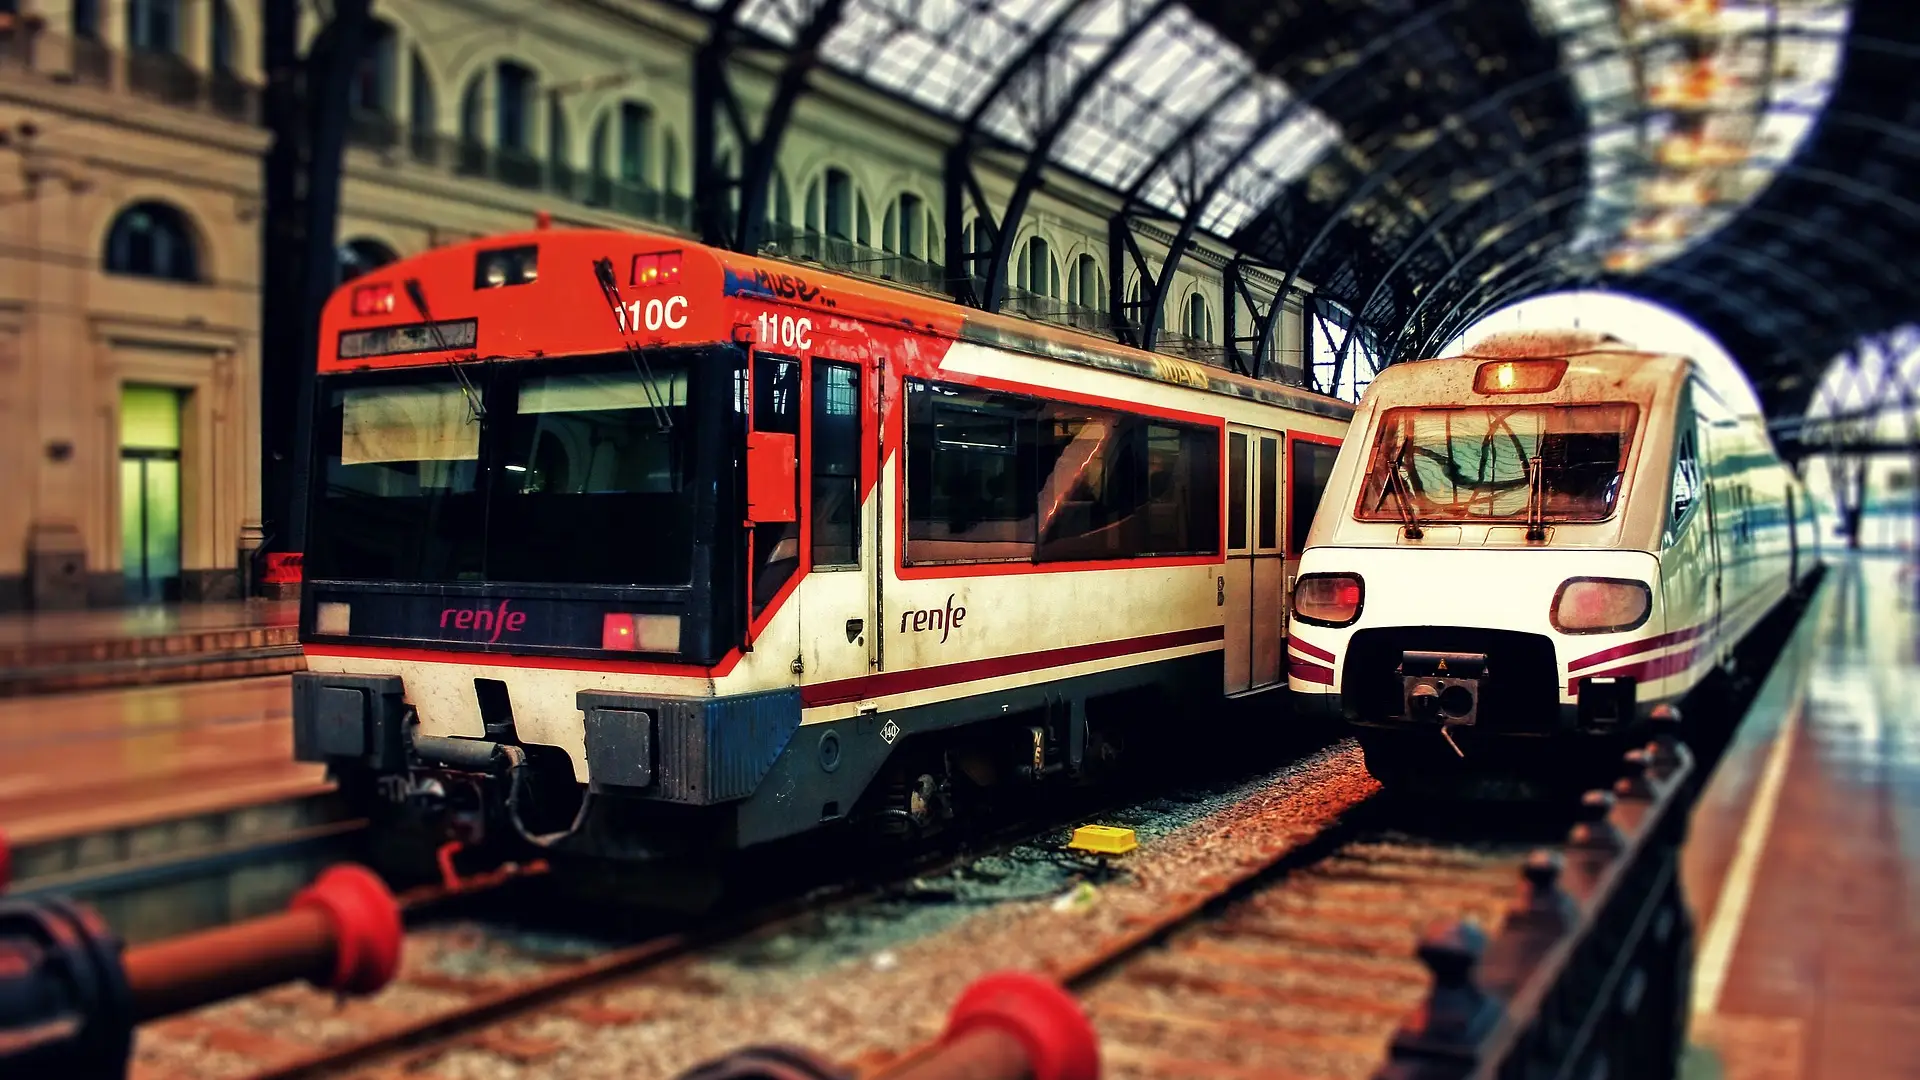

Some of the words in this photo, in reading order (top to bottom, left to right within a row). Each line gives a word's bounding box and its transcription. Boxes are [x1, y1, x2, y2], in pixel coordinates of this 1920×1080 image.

[614, 295, 689, 333] 110C
[758, 311, 812, 350] 110C
[439, 598, 527, 645] renfe
[899, 592, 967, 645] renfe
